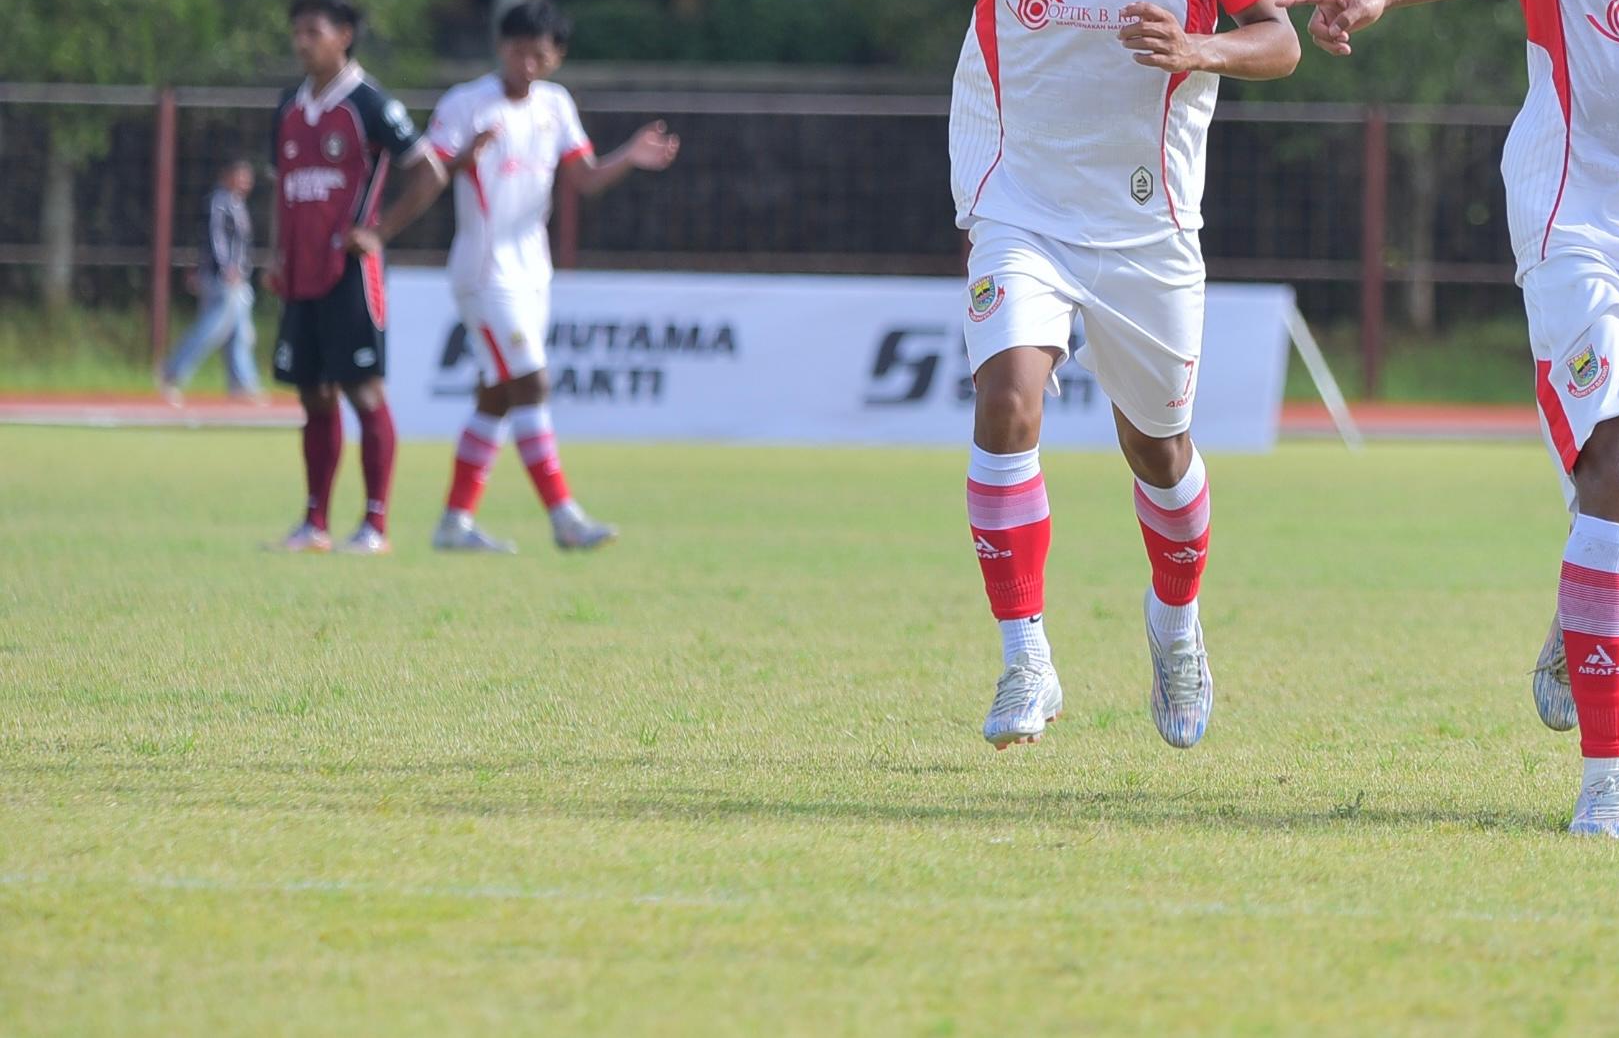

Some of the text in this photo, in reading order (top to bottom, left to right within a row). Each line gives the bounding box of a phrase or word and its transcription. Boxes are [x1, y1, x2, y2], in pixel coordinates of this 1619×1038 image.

[1048, 5, 1092, 23] OPTIK
[1099, 9, 1112, 23] B.
[553, 367, 666, 397] AKTI
